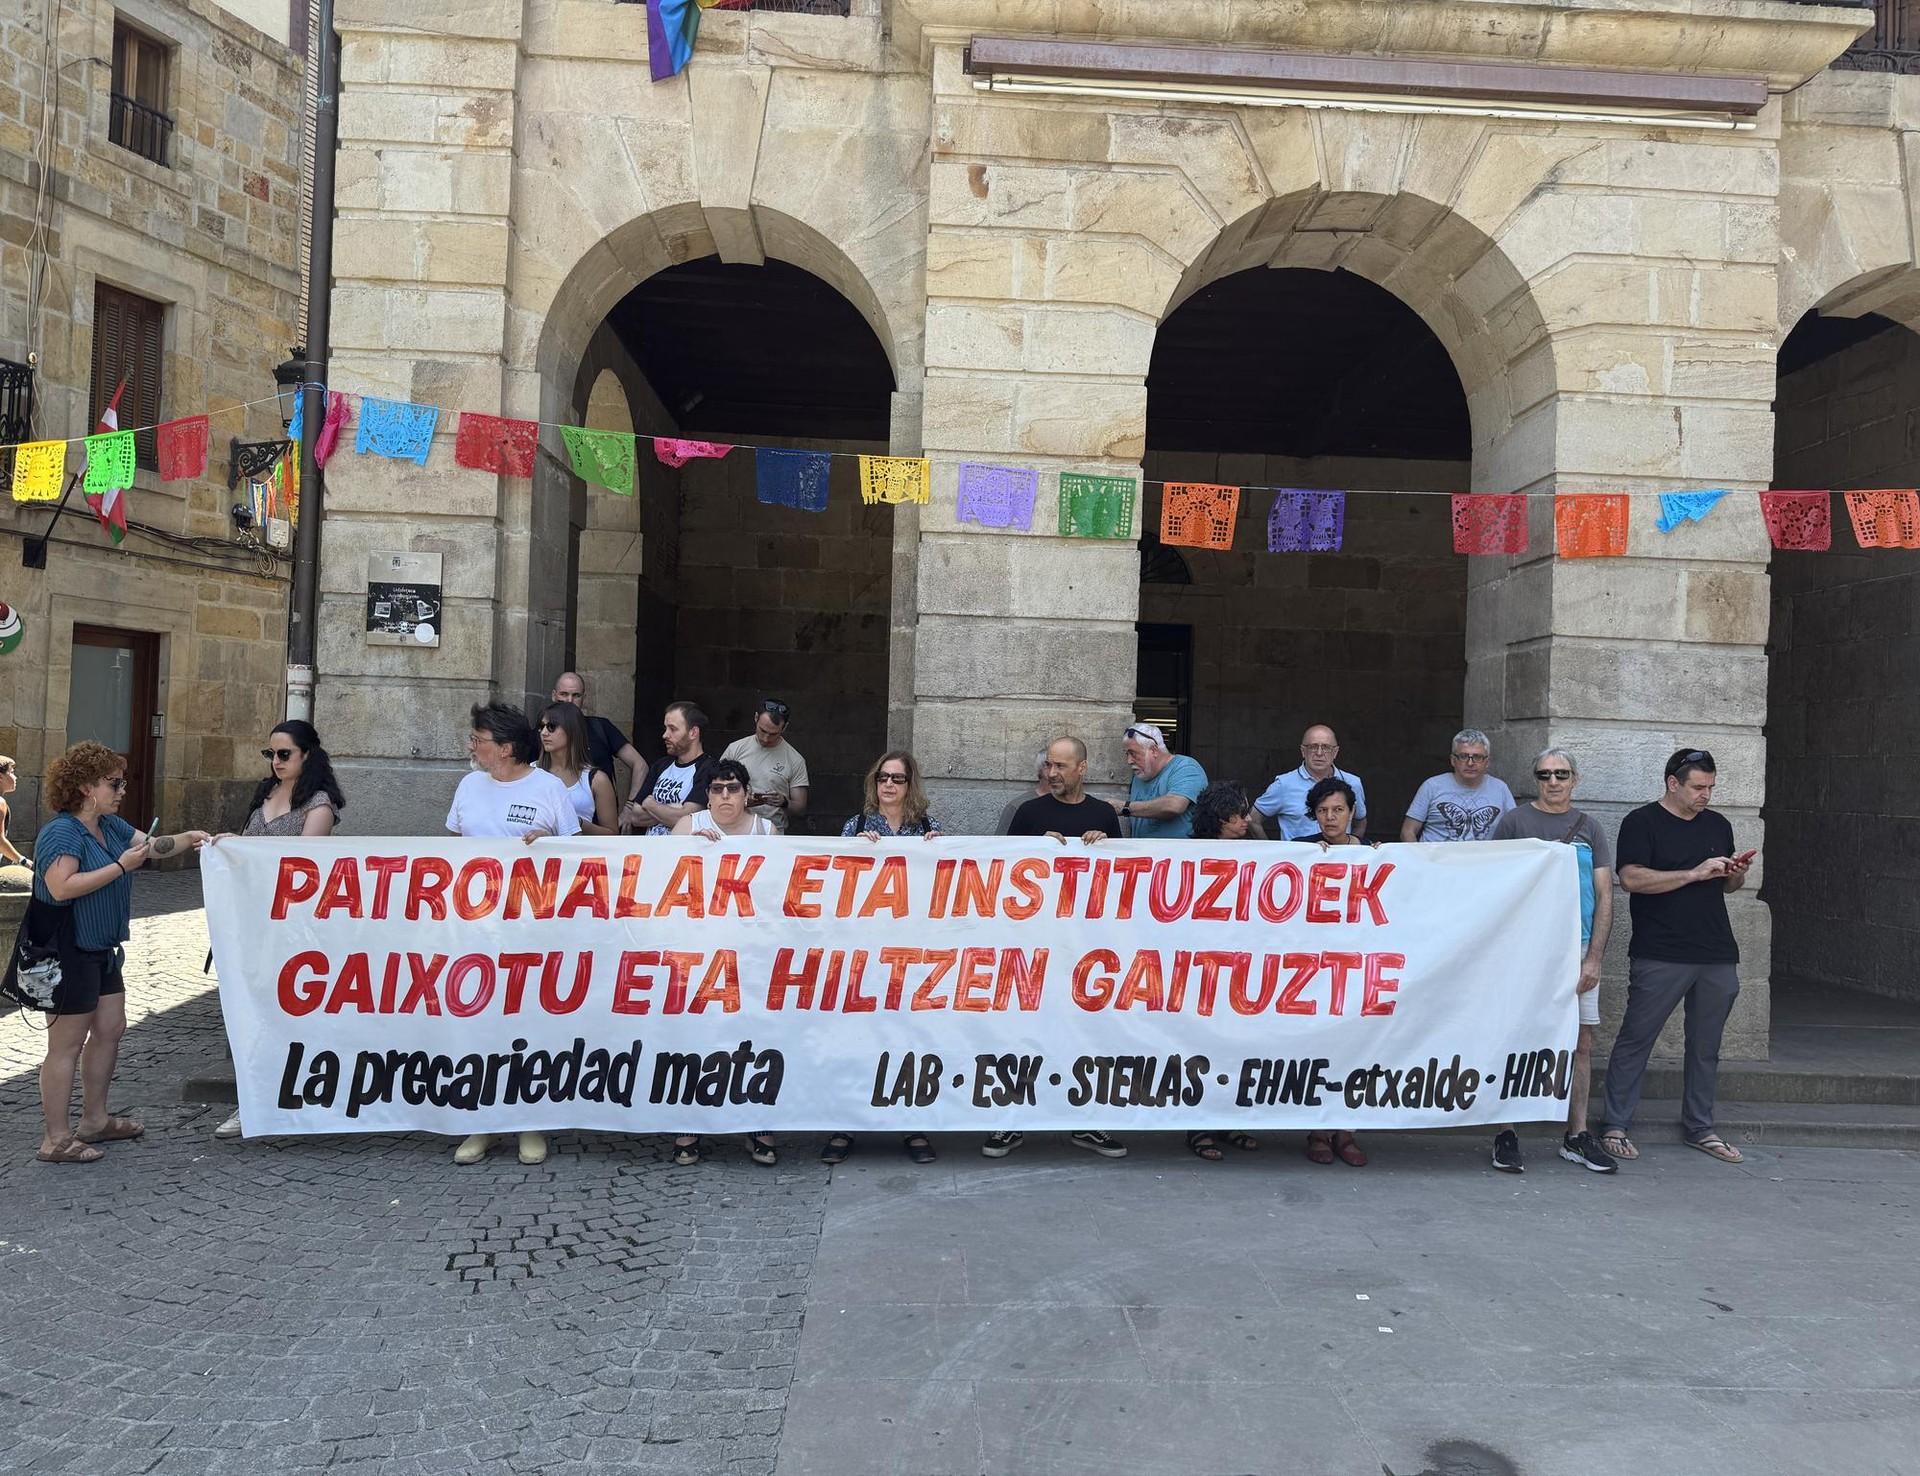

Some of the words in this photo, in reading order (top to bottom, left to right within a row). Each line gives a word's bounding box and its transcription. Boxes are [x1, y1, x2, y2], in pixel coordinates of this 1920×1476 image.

[271, 854, 764, 920] PATRONALAK
[783, 855, 908, 918] ETA
[928, 856, 1396, 925] INSTITUZIOEK
[277, 950, 593, 1017] GAIXOTU
[611, 950, 741, 1014] ETA
[766, 948, 1049, 1013] HILTZEN
[1071, 948, 1405, 1017] GAITUZTE
[277, 1042, 338, 1109] La
[345, 1037, 643, 1118] precariedad
[649, 1040, 785, 1107] mata
[870, 1051, 944, 1108] LAB
[972, 1053, 1044, 1108] ESK
[1067, 1053, 1211, 1108] STEILAS
[1236, 1054, 1481, 1112] EHNE-etxalde
[1499, 1048, 1575, 1101] HIRU
